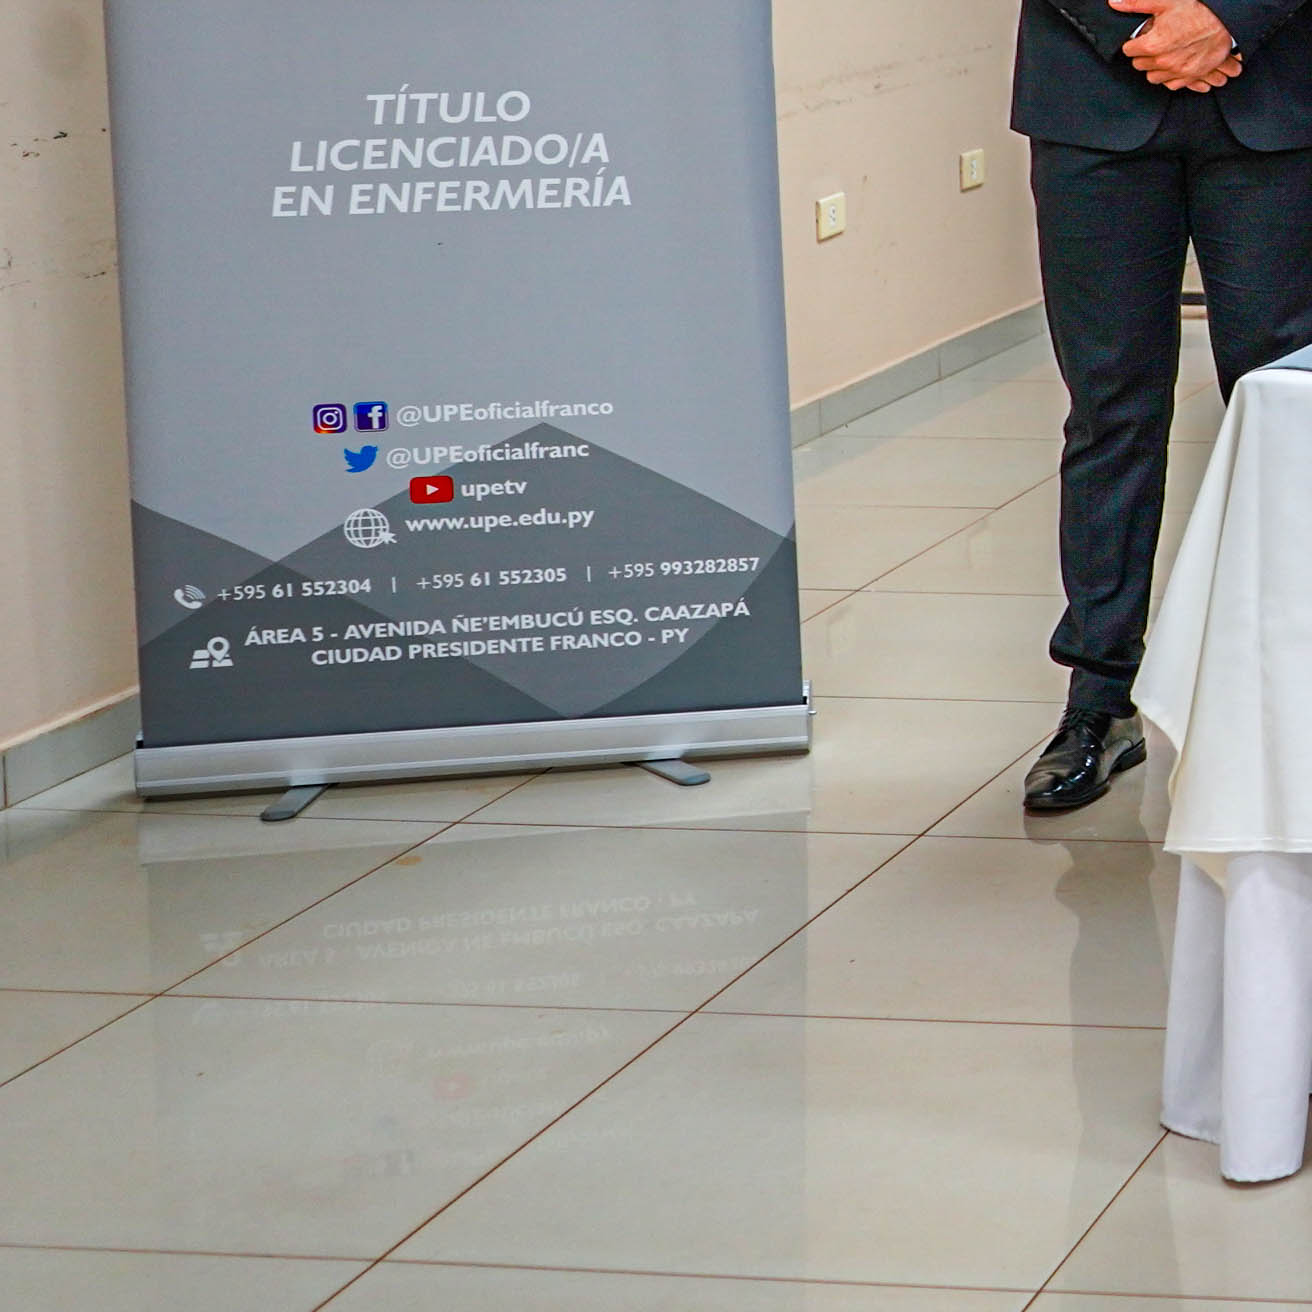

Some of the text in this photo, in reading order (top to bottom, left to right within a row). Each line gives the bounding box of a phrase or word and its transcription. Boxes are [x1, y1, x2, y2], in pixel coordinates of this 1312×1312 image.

[366, 83, 531, 125] TÍTULO
[290, 132, 610, 174] LICENCIADO/A
[271, 168, 632, 217] EN ENFERMERÍA
[396, 399, 614, 427] @UPEoficialfranco
[386, 441, 589, 470] @UPEoficialfranc
[460, 479, 528, 502] upetv
[404, 507, 596, 533] www.upe.edu.py
[415, 567, 568, 590] +595 61 552305
[607, 556, 761, 579] +595 993282857
[216, 577, 372, 601] +595 61 552304
[243, 624, 307, 647] ÁREA
[311, 626, 325, 642] 5
[343, 618, 447, 640] AVENIDA
[589, 607, 639, 626] ESQ.
[643, 597, 751, 622] CAAZAPÁ
[311, 645, 402, 666] CIUDAD
[408, 636, 545, 660] PRESIDENTE
[549, 630, 642, 651] FRANCO
[661, 627, 690, 644] PY
